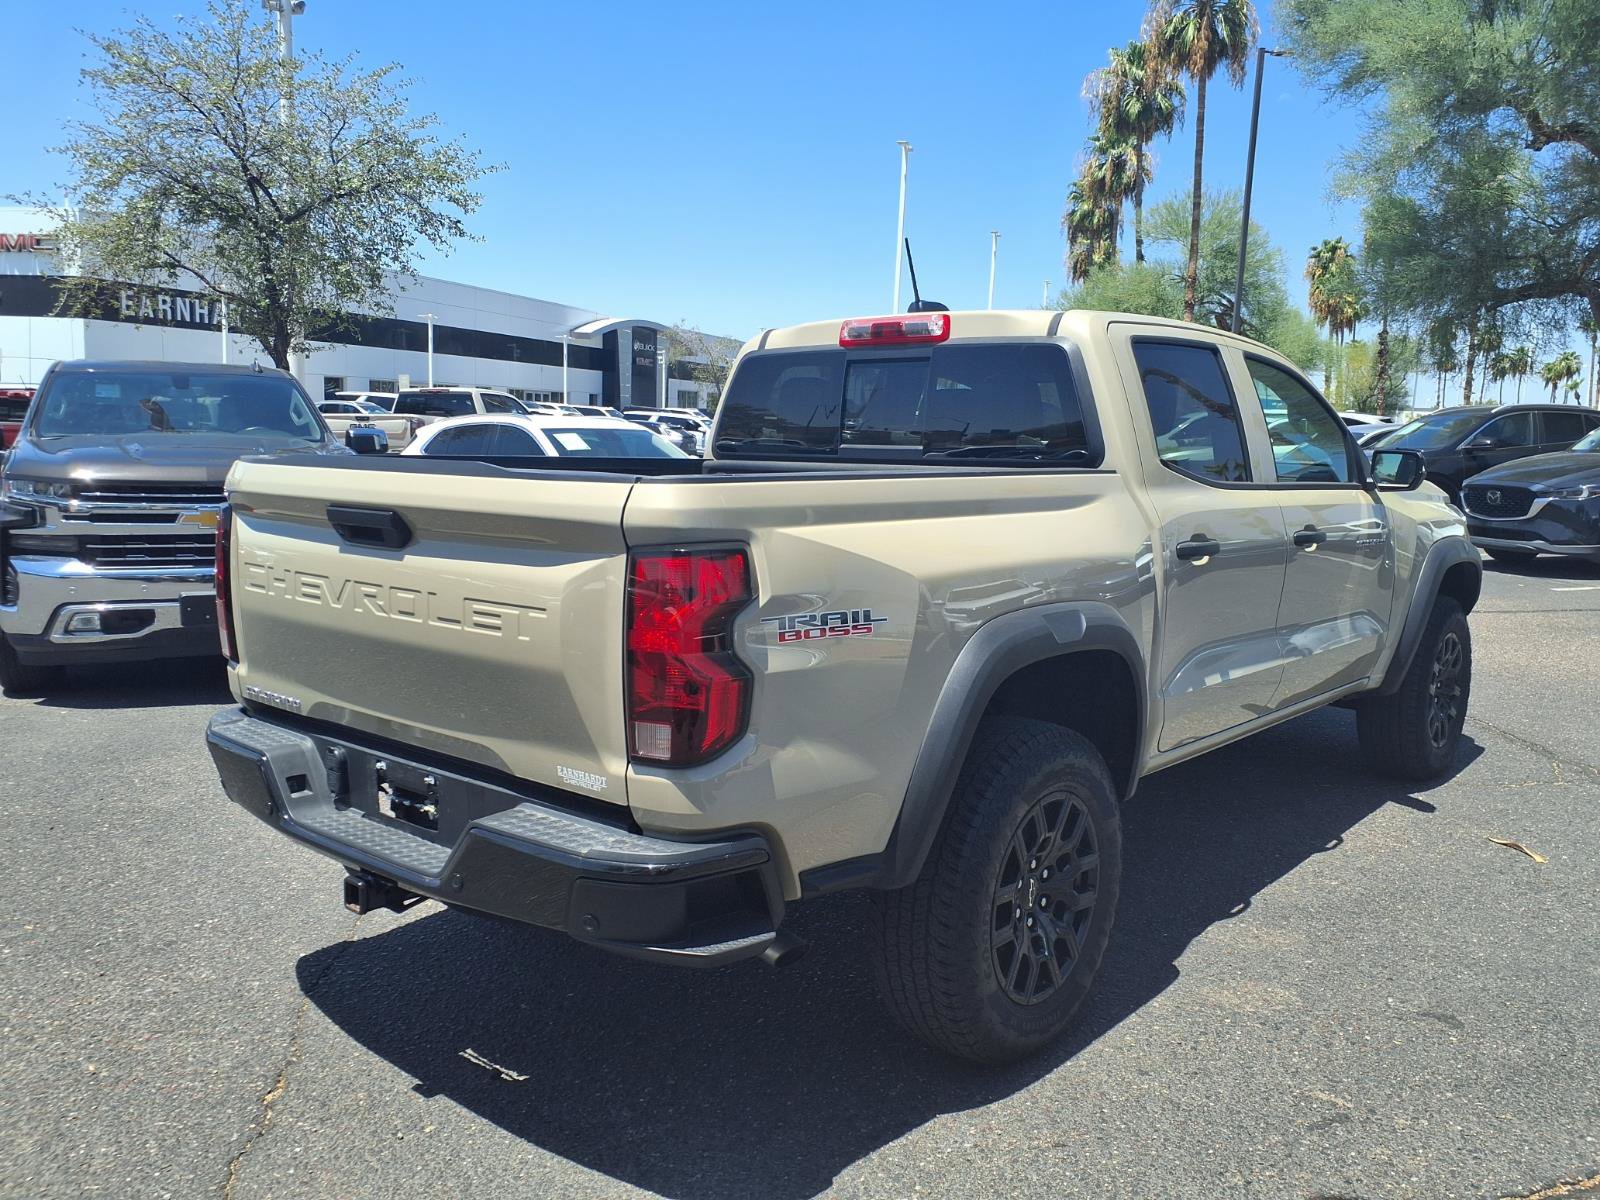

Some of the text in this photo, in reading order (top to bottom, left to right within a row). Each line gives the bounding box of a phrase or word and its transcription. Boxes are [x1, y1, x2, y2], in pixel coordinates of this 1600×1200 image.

[0, 233, 55, 252] MC
[240, 562, 548, 641] CHEVROLET
[760, 607, 888, 631] TRAIL
[777, 622, 874, 643] BOSS
[556, 765, 608, 788] EARNHARDT
